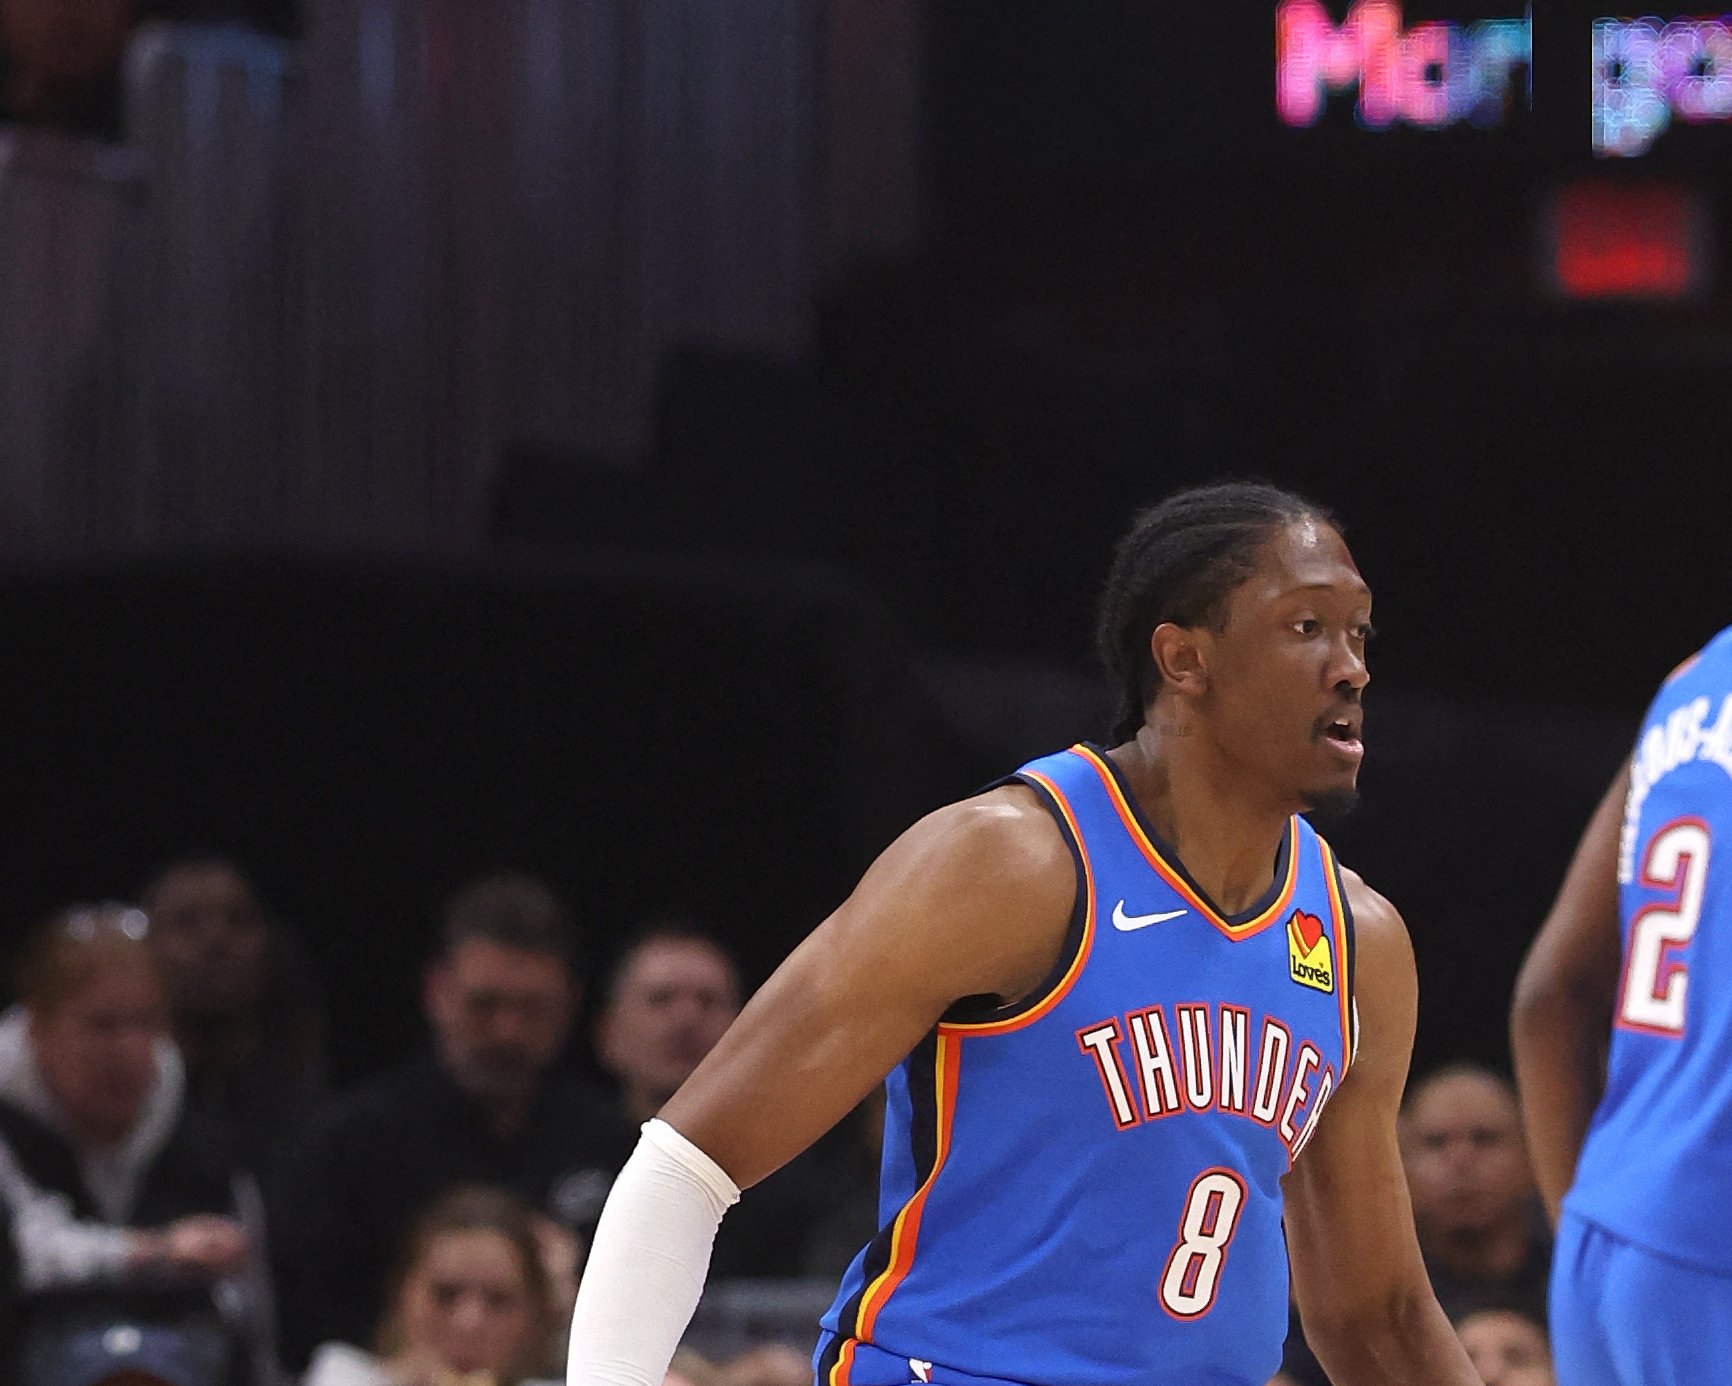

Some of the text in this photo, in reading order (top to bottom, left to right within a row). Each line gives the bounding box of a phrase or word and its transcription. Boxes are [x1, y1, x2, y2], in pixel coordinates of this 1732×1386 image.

[1291, 953, 1331, 986] Love's
[1613, 815, 1712, 1039] 2
[1158, 1168, 1248, 1320] 8
